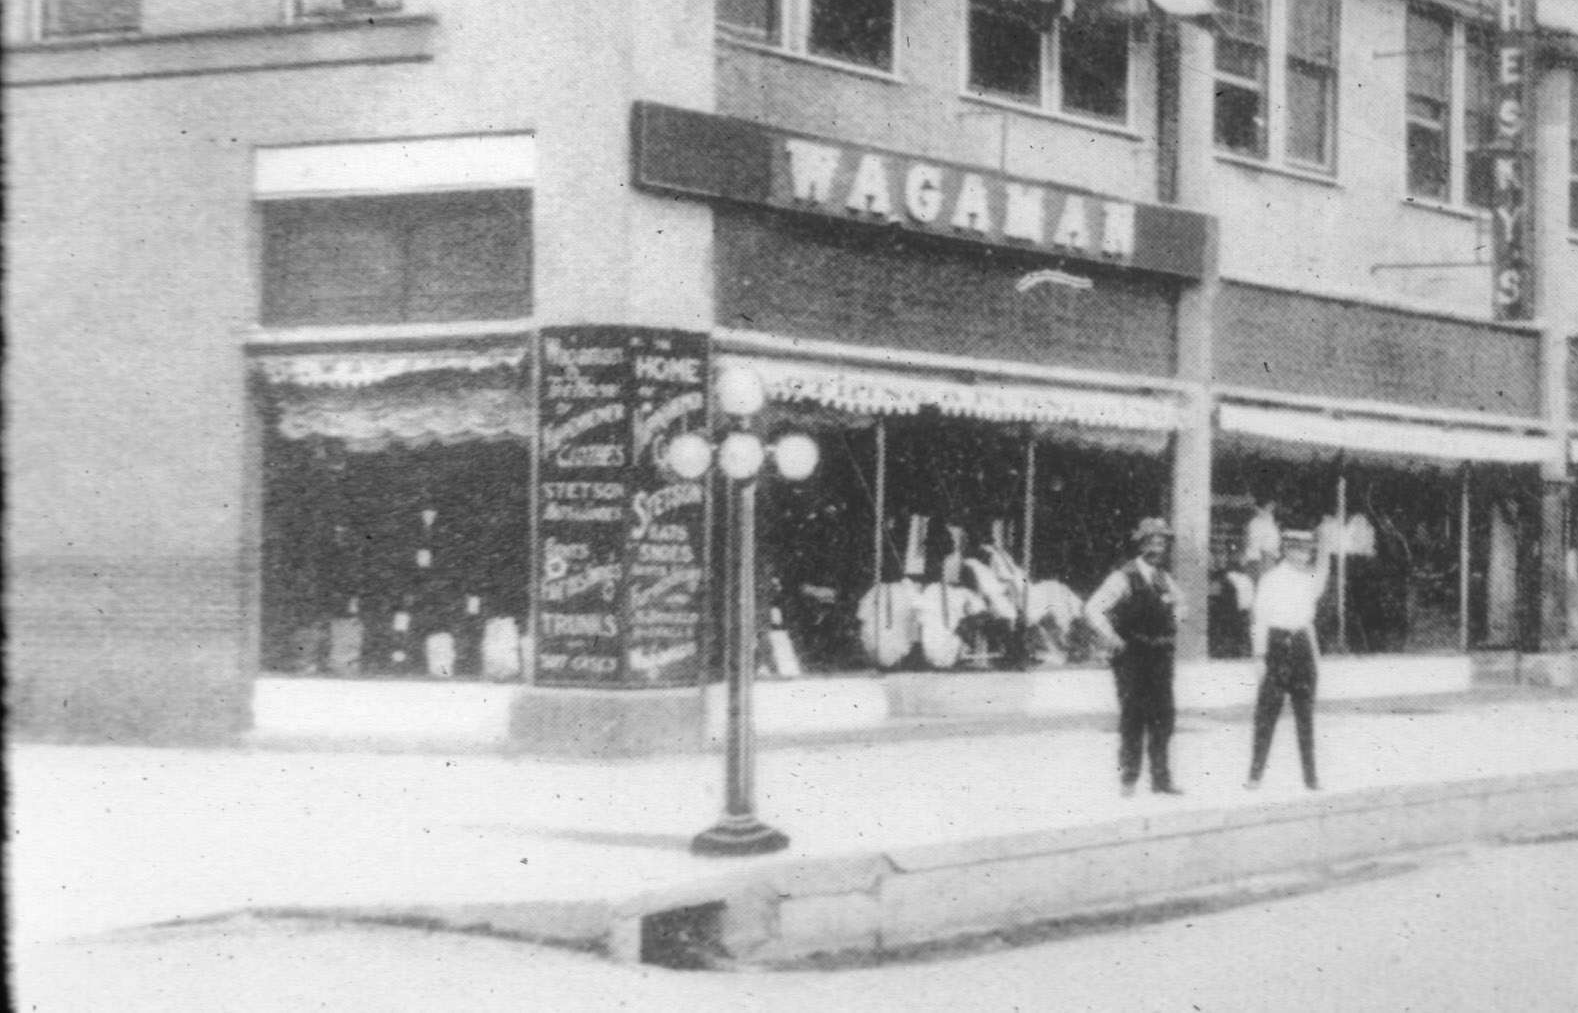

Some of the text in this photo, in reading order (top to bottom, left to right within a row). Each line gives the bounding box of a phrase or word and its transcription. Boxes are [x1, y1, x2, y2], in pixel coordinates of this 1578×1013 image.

[786, 138, 1135, 261] WAGAMAN
[635, 355, 701, 383] HOME
[541, 481, 625, 499] STETSON
[540, 611, 619, 639] TRUNKS
